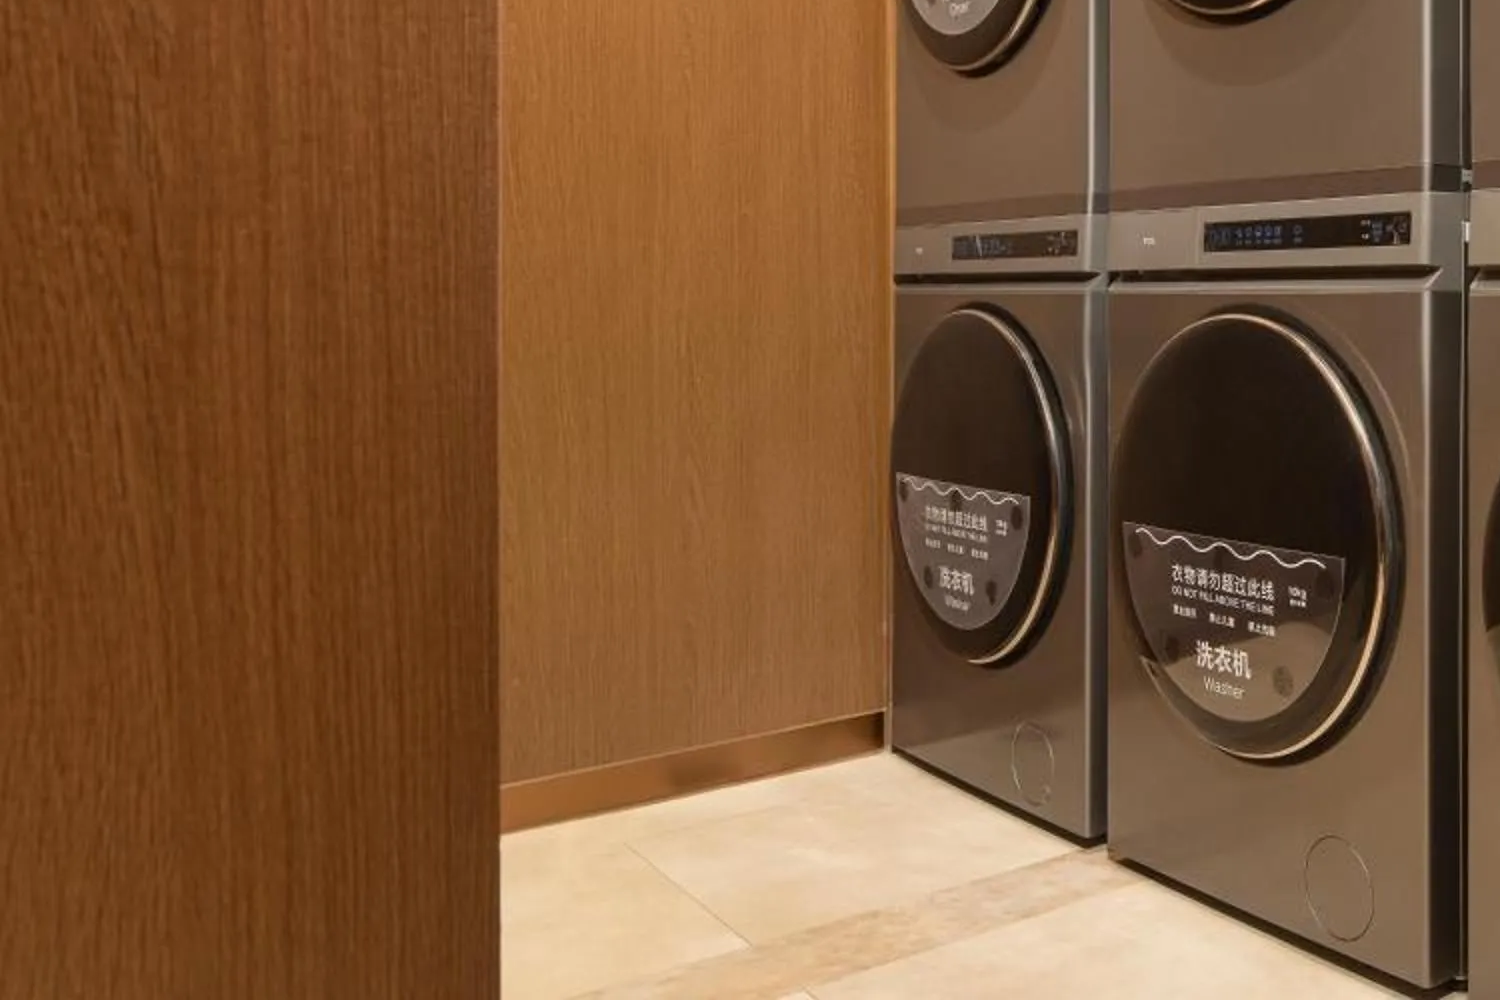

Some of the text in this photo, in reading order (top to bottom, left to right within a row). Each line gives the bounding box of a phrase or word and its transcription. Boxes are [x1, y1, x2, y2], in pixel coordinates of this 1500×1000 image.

[1195, 640, 1252, 679] 洗衣机
[1204, 676, 1246, 700] Washer
